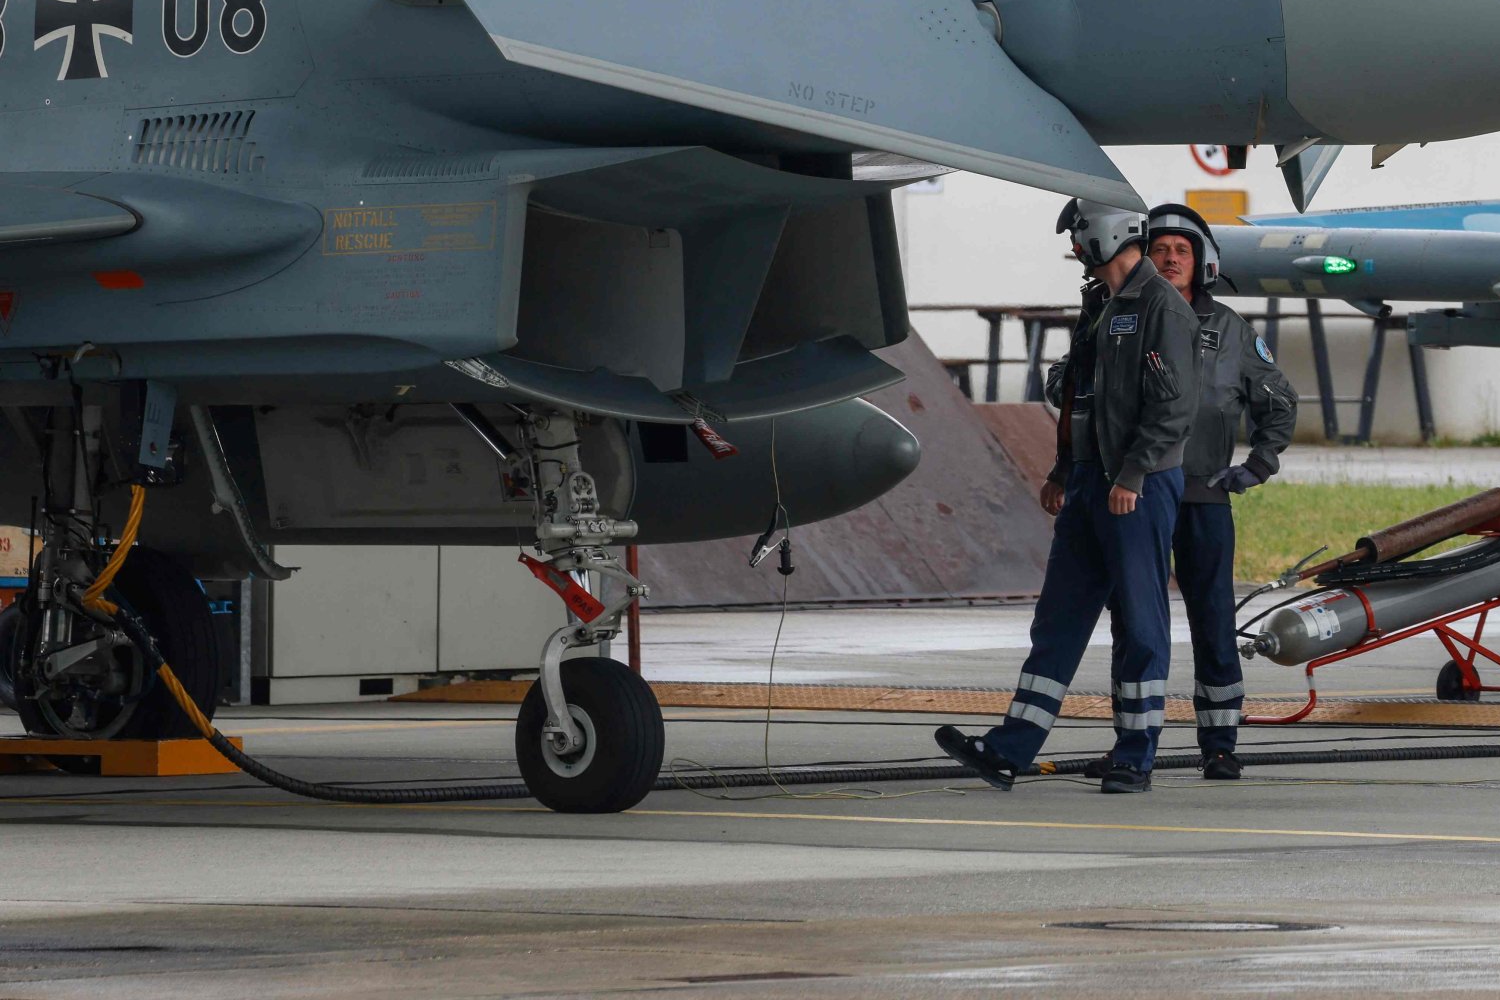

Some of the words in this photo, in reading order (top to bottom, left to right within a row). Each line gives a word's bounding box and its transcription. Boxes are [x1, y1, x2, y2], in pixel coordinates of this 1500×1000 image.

[788, 81, 815, 101] NO
[825, 90, 876, 115] STEP
[334, 210, 398, 229] NOTFALL
[336, 232, 393, 250] RESCUE
